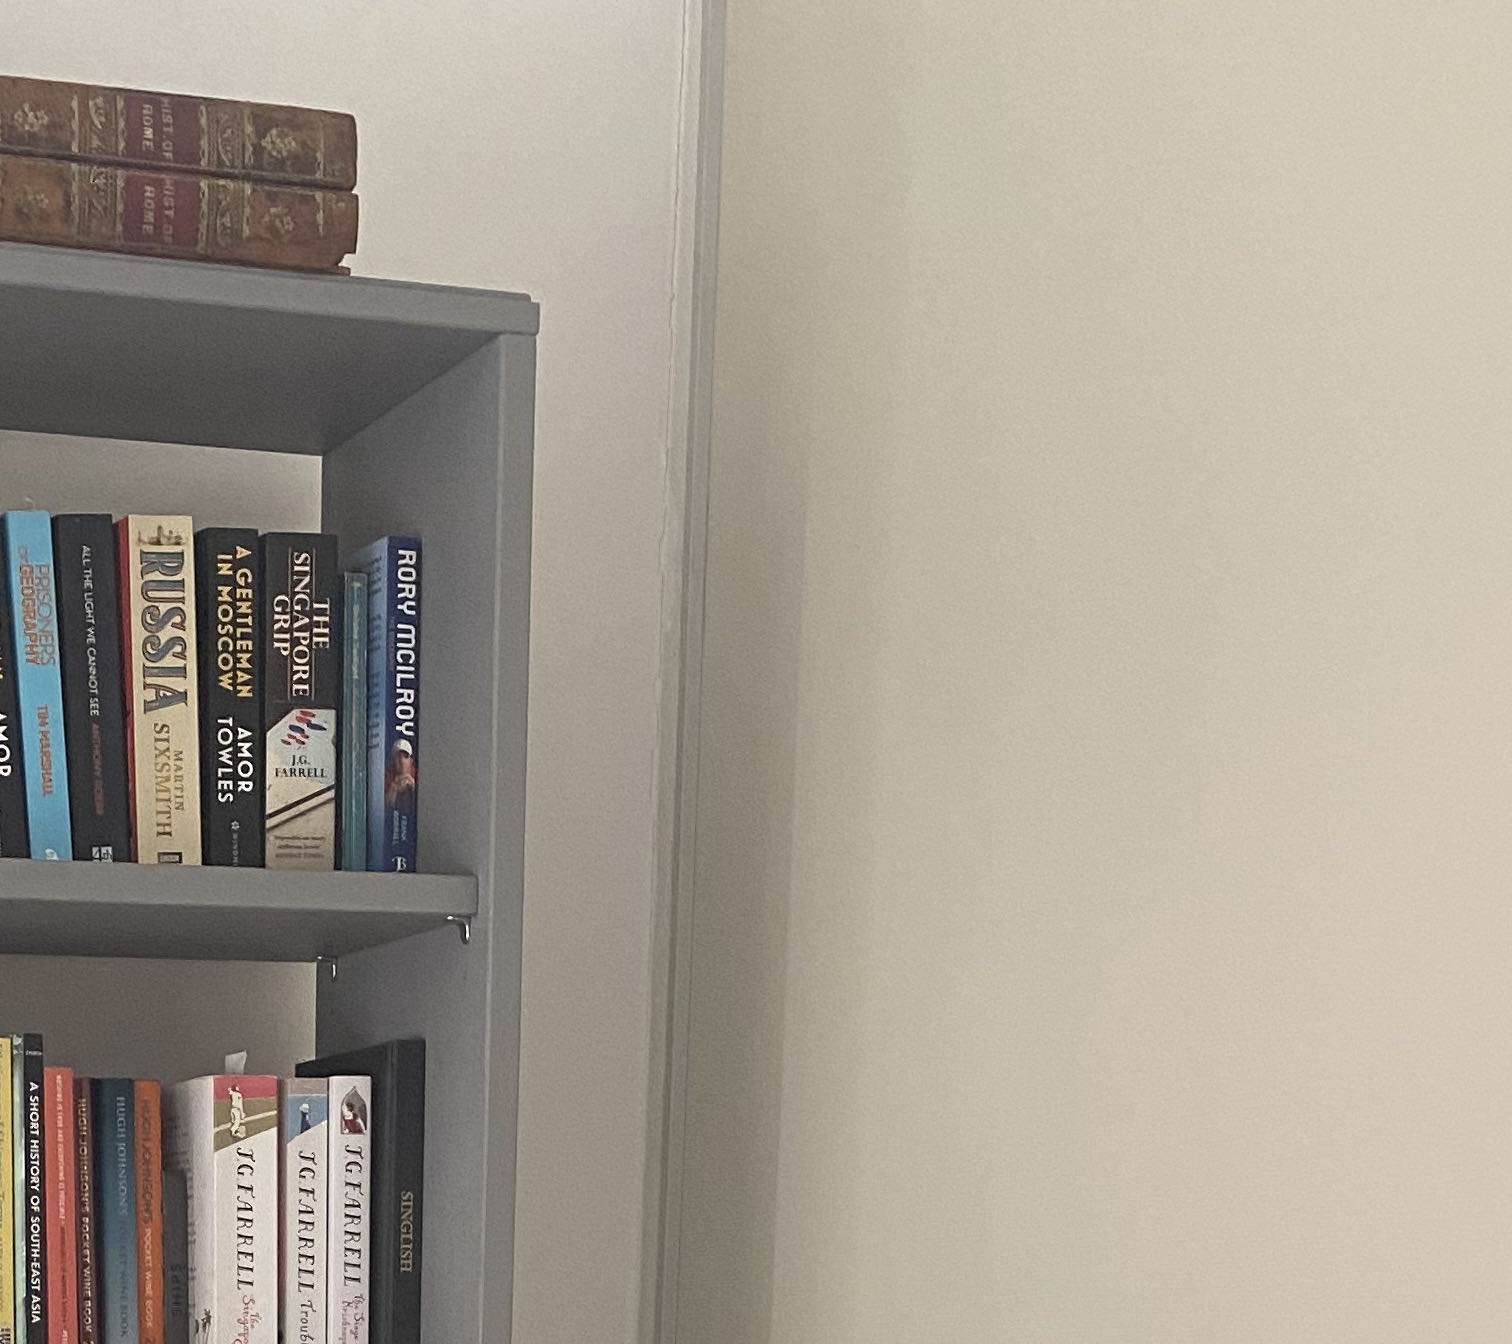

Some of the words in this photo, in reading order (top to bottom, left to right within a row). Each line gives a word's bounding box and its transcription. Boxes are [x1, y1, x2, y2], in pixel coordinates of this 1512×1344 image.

[82, 545, 91, 566] ALL
[84, 569, 93, 593] THE
[217, 554, 233, 574] IN
[236, 546, 251, 558] A
[397, 549, 416, 615] RORY
[85, 596, 95, 624] LIGHT
[86, 627, 95, 645] WE
[140, 549, 189, 714] RUSSIA
[217, 582, 234, 692] MOSCOW
[236, 568, 253, 697] GENTLEMAN
[273, 594, 290, 656] GRIP
[292, 551, 311, 697] SINGAPORE
[314, 598, 330, 648] THE
[87, 648, 99, 694] CANNOT
[395, 624, 415, 736] MCILROY
[89, 698, 99, 716] SEE
[153, 722, 172, 837] SIXSMITH
[173, 750, 184, 811] MARTIN
[217, 717, 233, 803] TOWLES
[237, 727, 254, 792] AMOR
[275, 768, 328, 778] FARRELL
[30, 1082, 38, 1091] A
[30, 1096, 40, 1135] SHORT
[30, 1139, 41, 1195] HISTORY
[32, 1198, 41, 1212] OF
[343, 1182, 363, 1287] FARRELL
[400, 1191, 413, 1272] SINGLISH
[31, 1216, 41, 1295] SOUTH-EAST
[236, 1185, 253, 1290] FARRELL
[298, 1187, 316, 1292] FARRELL
[31, 1296, 41, 1323] ASIA
